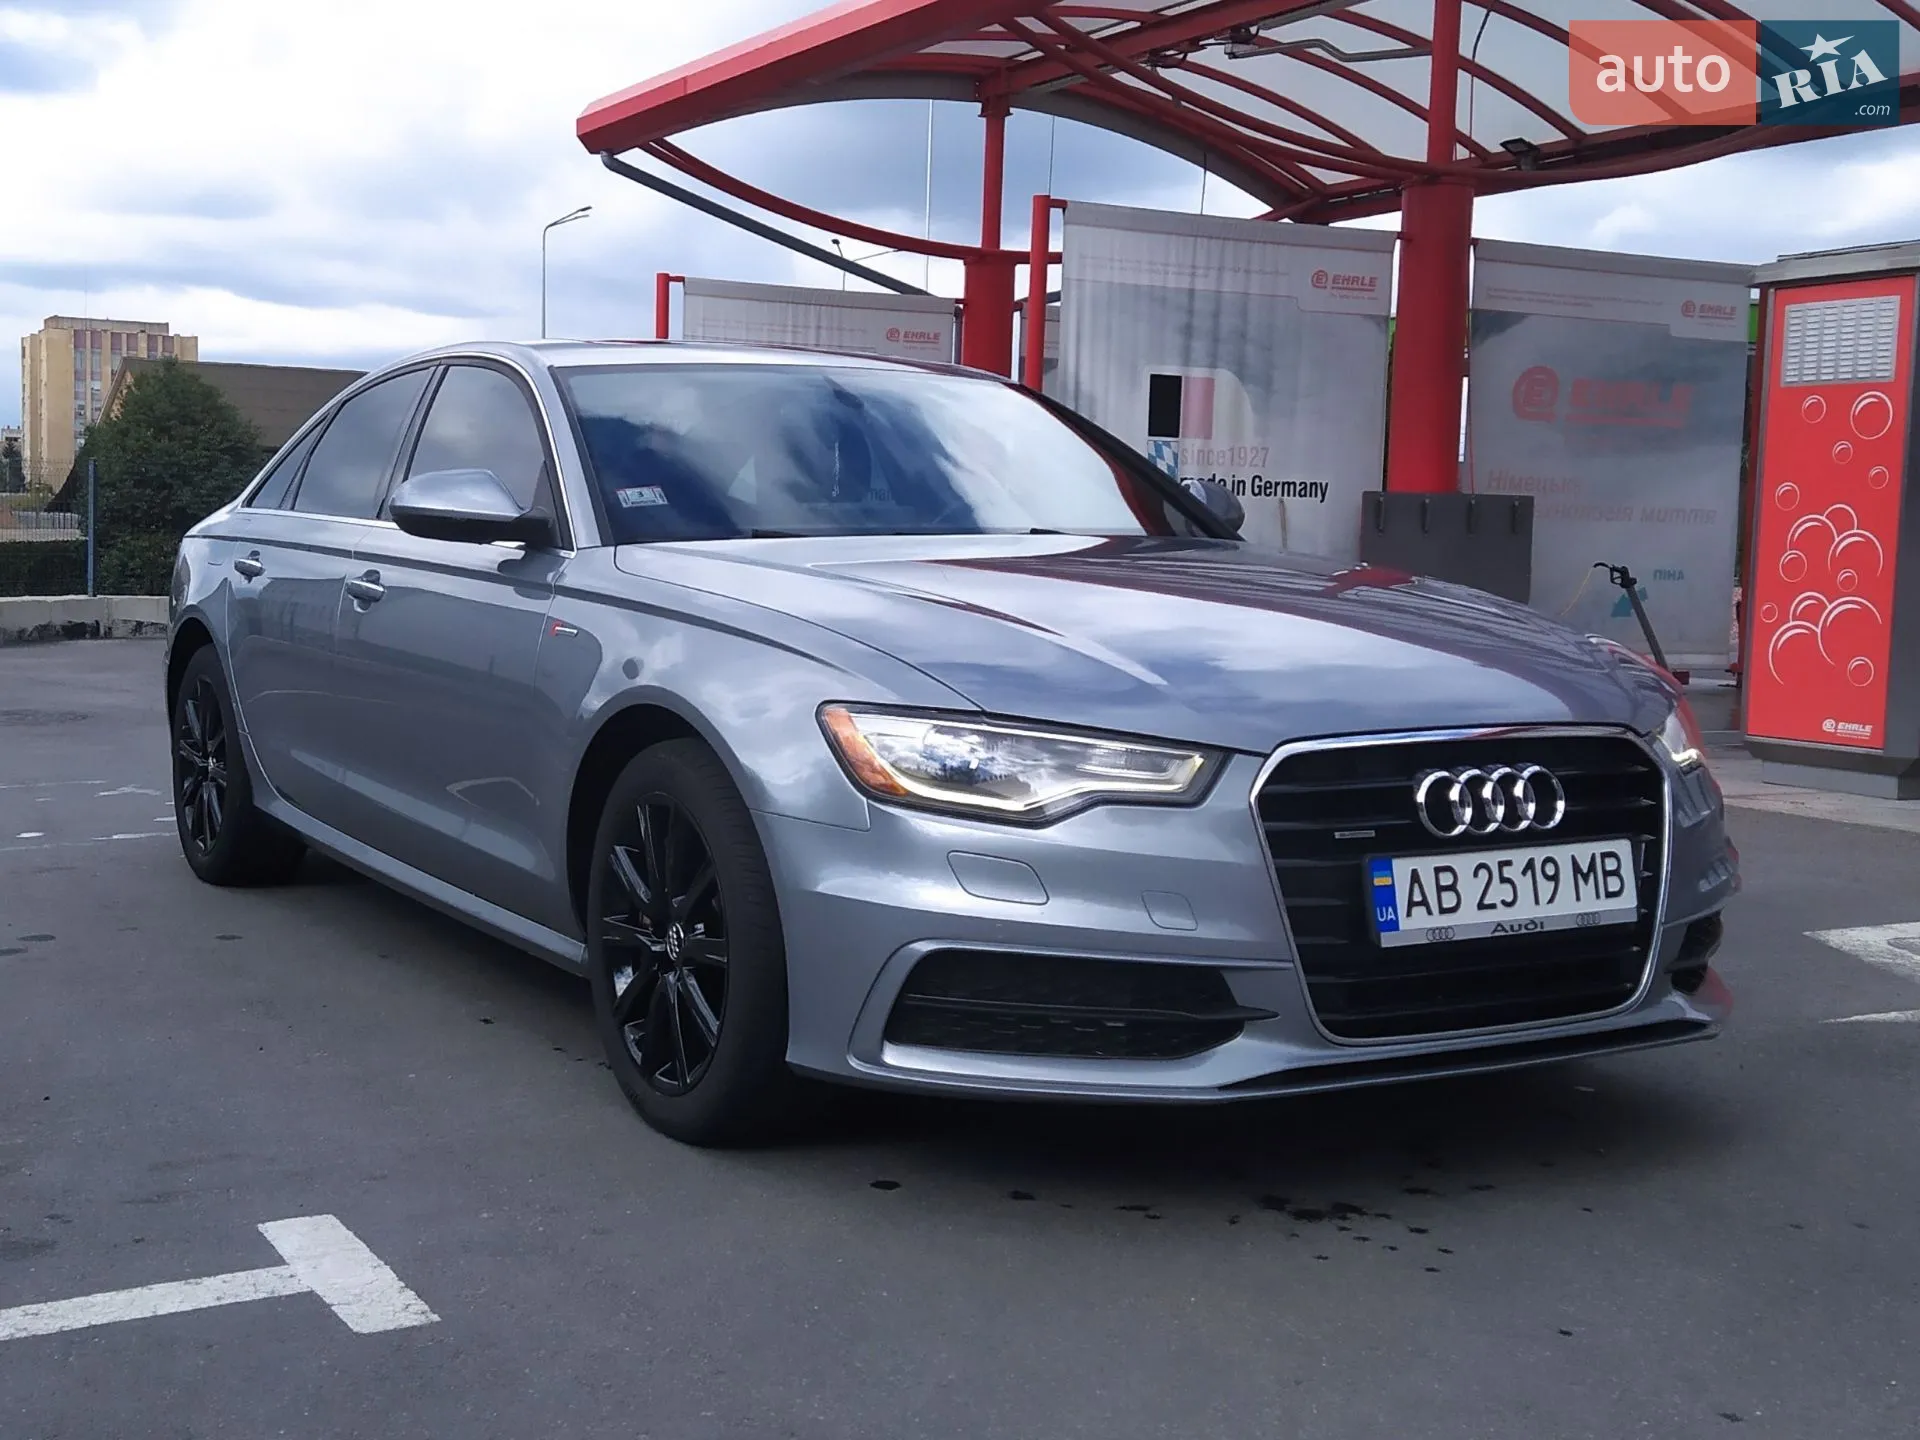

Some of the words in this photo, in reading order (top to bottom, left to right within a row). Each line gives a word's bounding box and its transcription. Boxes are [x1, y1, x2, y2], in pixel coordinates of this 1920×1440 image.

[1332, 274, 1378, 287] EHRLE
[1699, 303, 1737, 316] EHRLE
[903, 330, 941, 341] EHRLE
[1232, 474, 1246, 496] in
[1251, 475, 1329, 503] Germany
[1837, 722, 1872, 732] EHRLE
[1406, 865, 1462, 917] AB
[1473, 856, 1560, 911] 2519
[1571, 851, 1625, 902] MB
[1377, 906, 1397, 922] UA
[1492, 920, 1544, 935] Audi
